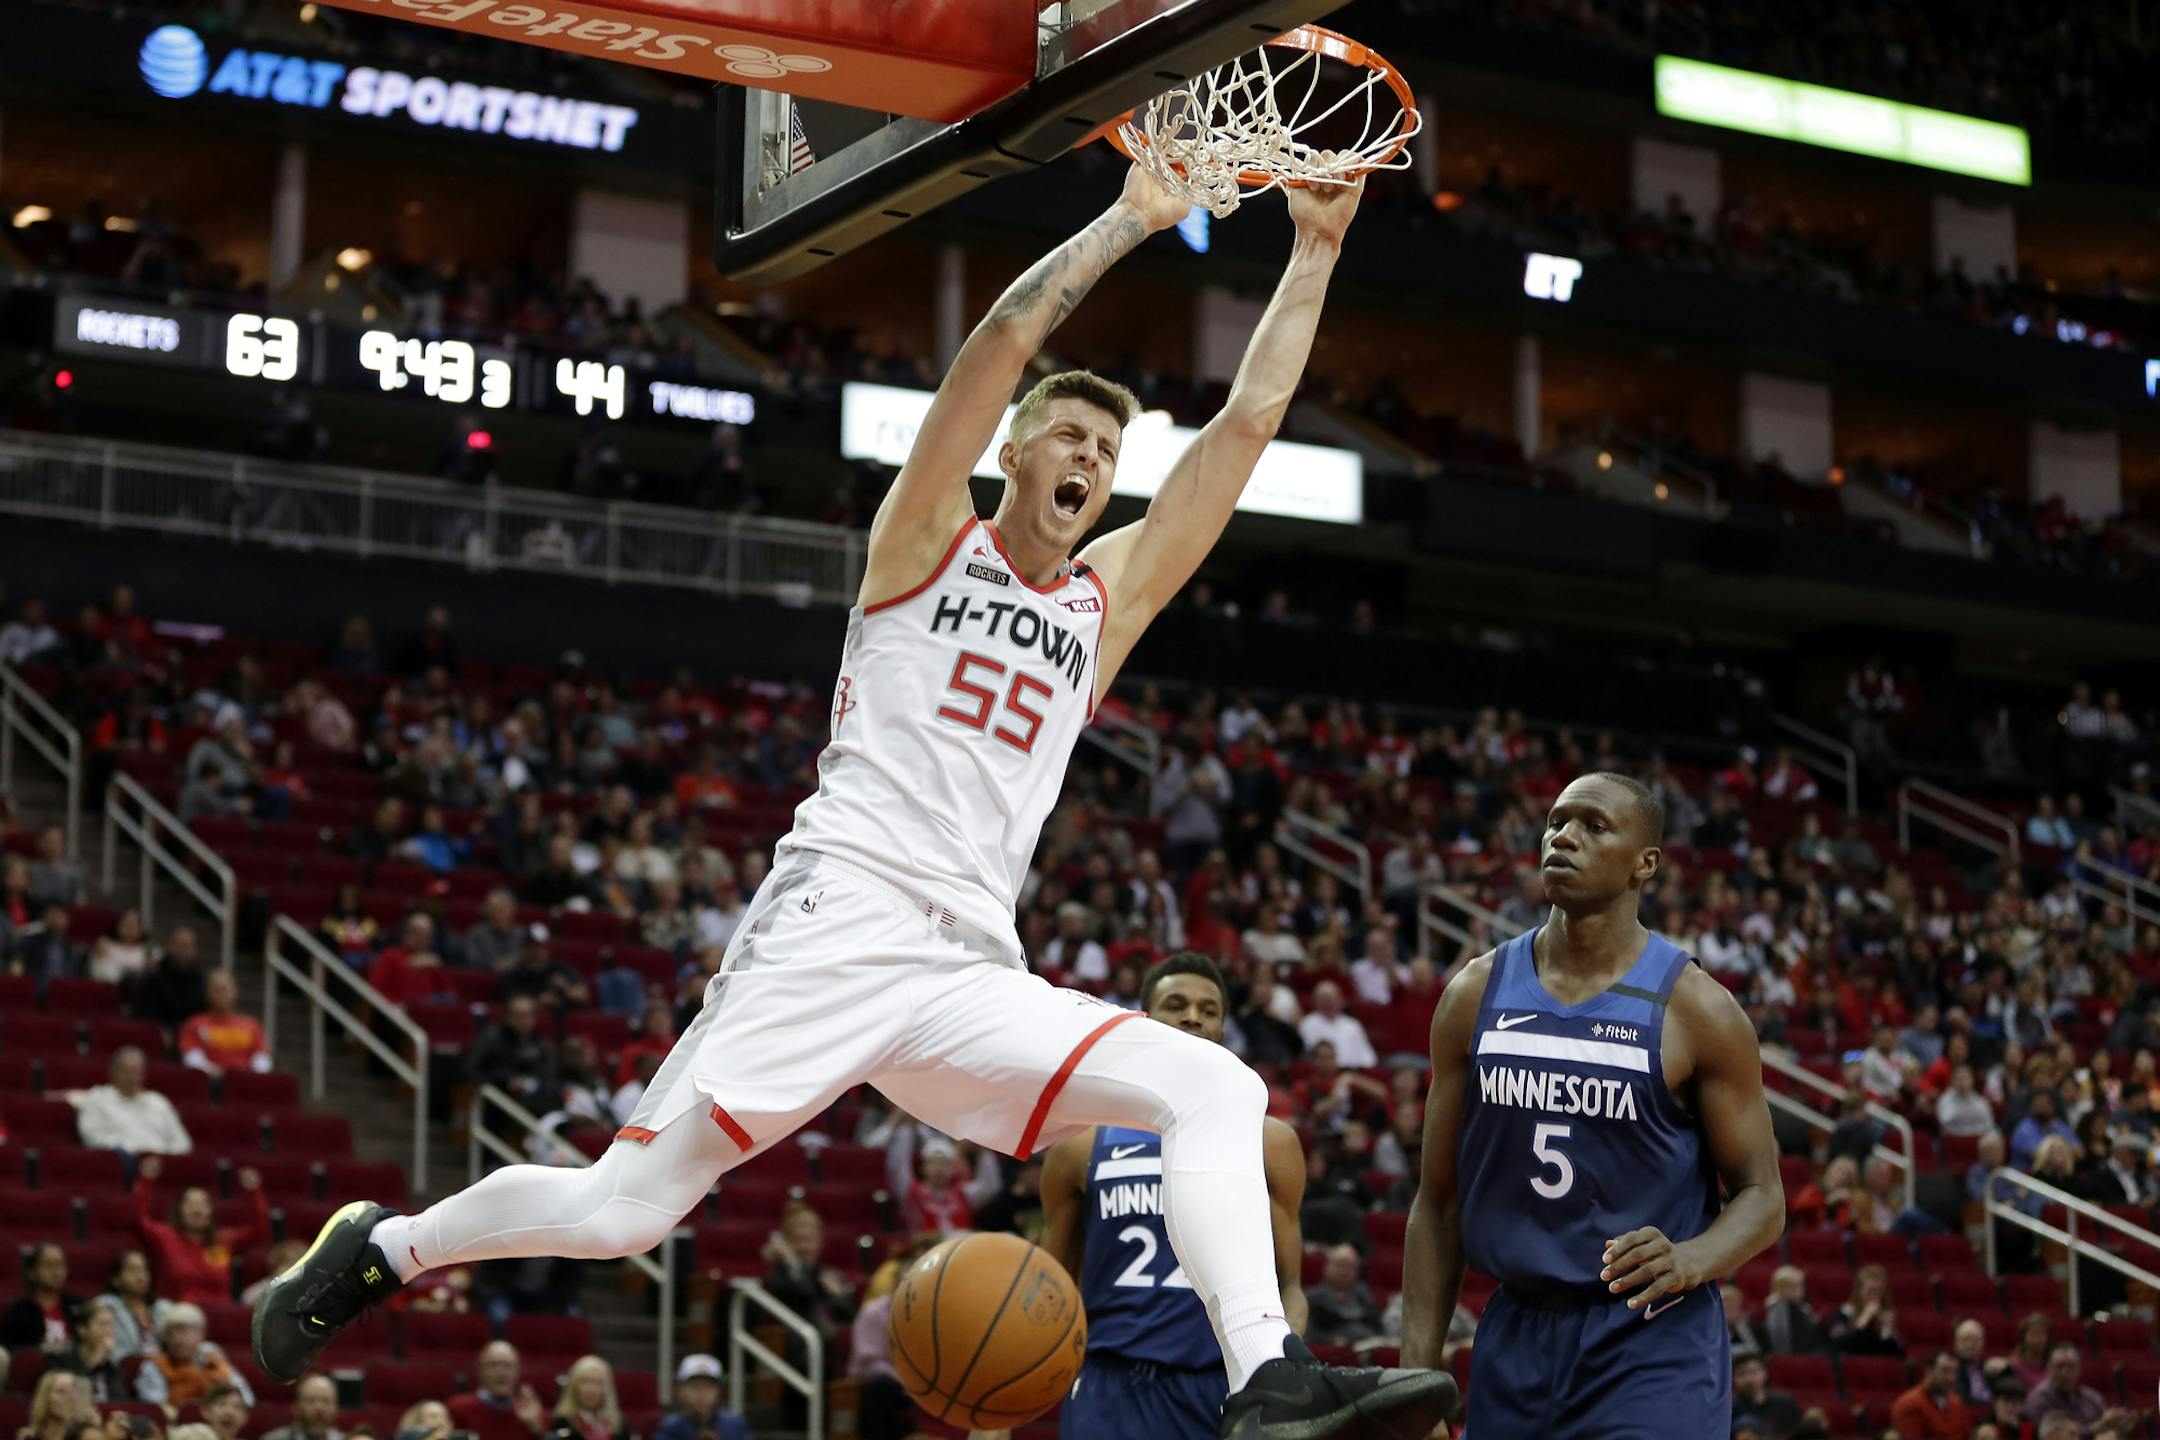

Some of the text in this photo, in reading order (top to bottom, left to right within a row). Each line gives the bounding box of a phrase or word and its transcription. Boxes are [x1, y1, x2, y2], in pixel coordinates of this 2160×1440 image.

[208, 48, 639, 152] AT&T SPORTSNET
[226, 313, 299, 381] 63
[556, 358, 625, 420] 44
[968, 565, 1007, 585] ROCKETS
[1064, 599, 1097, 612] KIT
[930, 595, 1088, 693] H-TOWN
[936, 650, 1054, 759] 55
[1605, 1025, 1639, 1041] fitbit
[1479, 1065, 1638, 1121] MINNESOTA
[1530, 1123, 1574, 1199] 5
